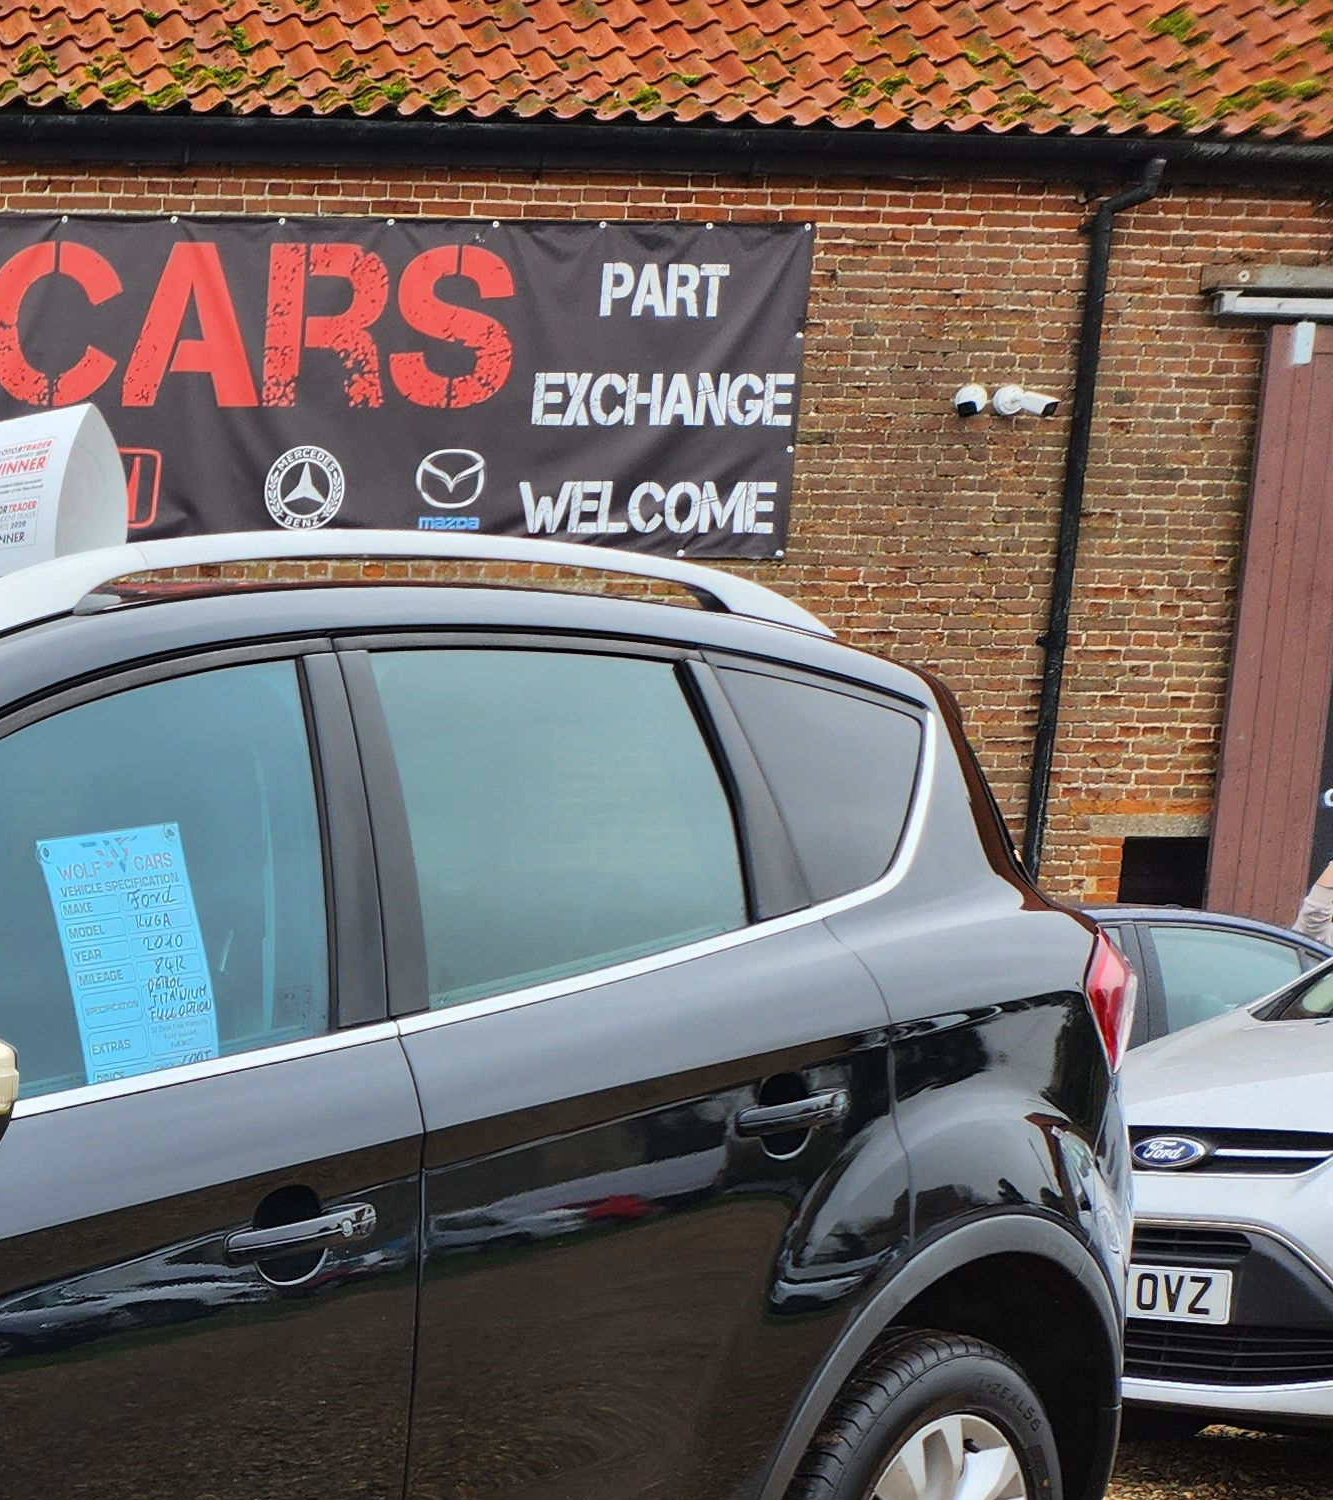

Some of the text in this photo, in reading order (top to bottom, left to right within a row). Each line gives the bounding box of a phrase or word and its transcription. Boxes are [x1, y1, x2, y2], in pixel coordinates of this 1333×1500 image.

[599, 262, 729, 318] PART
[531, 372, 794, 427] EXCHANGE
[277, 448, 336, 471] MERCEDES
[519, 481, 778, 535] WELCOME
[284, 516, 321, 528] BENZ
[57, 852, 174, 881] WOLF CARS
[60, 872, 179, 898] VEHICLE SPECIFICATION
[63, 902, 94, 917] MAKE
[68, 924, 105, 939] MODEL
[142, 933, 183, 951] 2010
[73, 948, 102, 963] YEAR
[79, 969, 123, 987] MILEAGE
[91, 1039, 131, 1056] EXTRAS
[1143, 1140, 1184, 1161] Ford
[1136, 1272, 1213, 1315] OVZ
